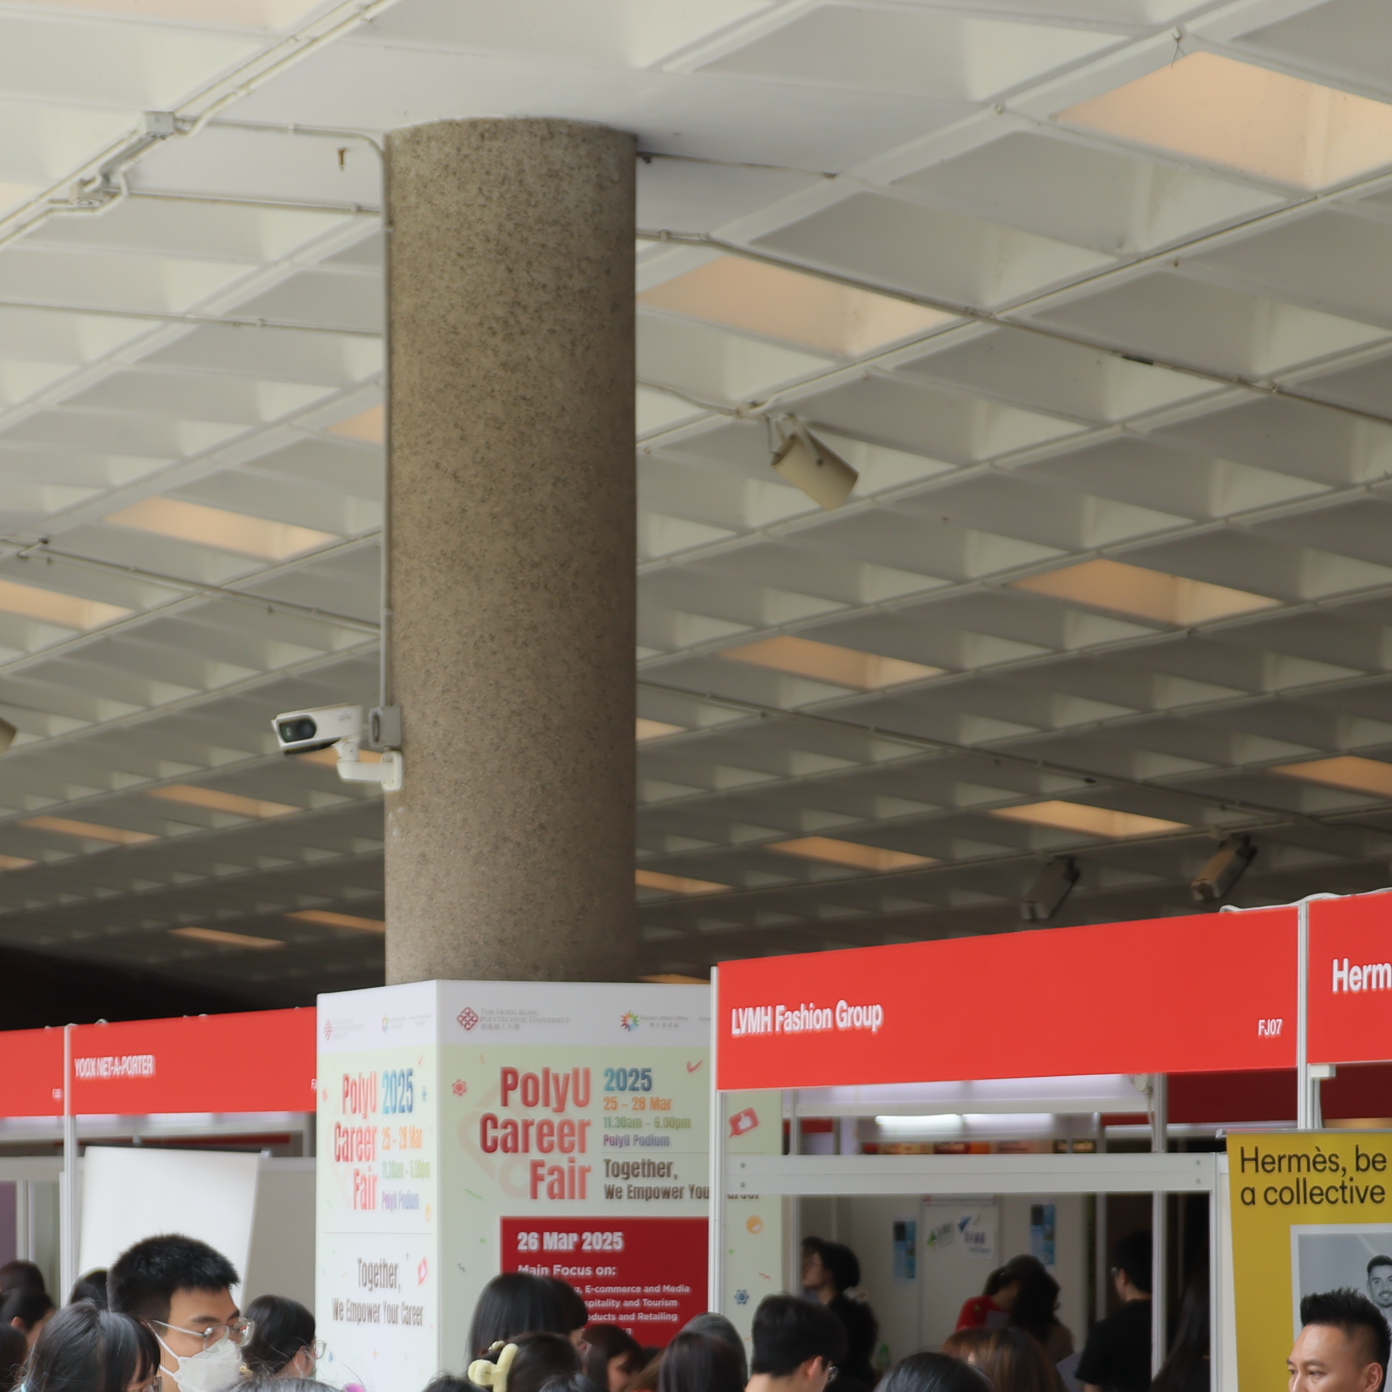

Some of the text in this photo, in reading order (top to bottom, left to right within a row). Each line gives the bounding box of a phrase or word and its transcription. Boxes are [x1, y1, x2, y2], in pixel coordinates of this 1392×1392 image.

[731, 999, 883, 1036] LVMH Fashion Group
[1258, 1018, 1283, 1036] FJ07
[382, 1067, 413, 1114] 2025
[500, 1066, 592, 1113] PolyU
[603, 1067, 652, 1092] 2025
[342, 1071, 377, 1119] PolyU
[603, 1097, 618, 1110] 25
[631, 1097, 646, 1111] 28
[649, 1097, 673, 1111] Mar
[479, 1112, 592, 1153] Career
[603, 1116, 642, 1129] 11.30am
[654, 1116, 691, 1131] 6.00pm
[334, 1121, 378, 1162] Career
[603, 1133, 670, 1148] PolyU Podium
[603, 1159, 678, 1180] Together,
[1240, 1145, 1348, 1178] Hermès,
[1355, 1145, 1388, 1173] be
[353, 1165, 378, 1210] Fair
[530, 1157, 592, 1200] Fair
[1239, 1184, 1257, 1206] a
[1263, 1177, 1385, 1205] collective
[604, 1184, 623, 1200] We
[627, 1184, 684, 1201] Empower
[688, 1184, 710, 1200] You
[517, 1231, 624, 1250] 26 Mar 2025
[357, 1257, 401, 1293] Together,
[518, 1264, 617, 1276] Main Focus on:
[585, 1285, 641, 1293] E-commerce
[643, 1284, 660, 1293] and
[663, 1284, 690, 1293] Media
[332, 1298, 424, 1326] We Empower Your Career
[584, 1298, 678, 1309] spitality and Tourism
[587, 1312, 678, 1322] oducts and Retailing
